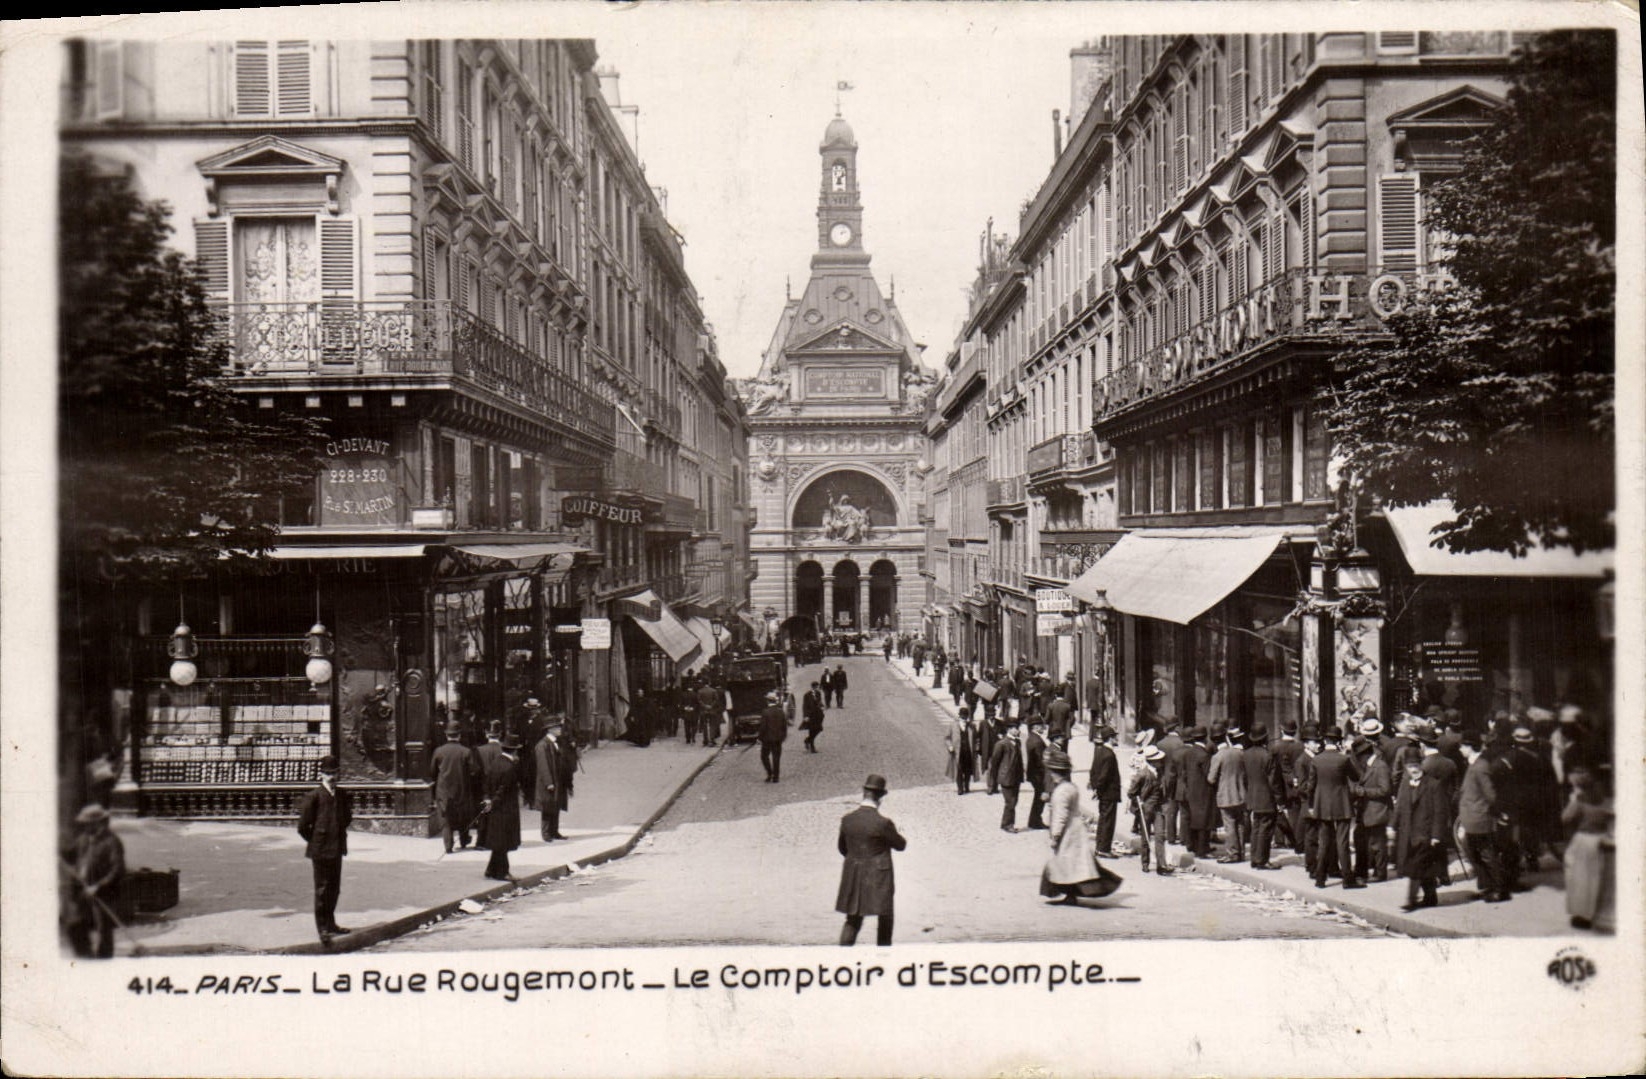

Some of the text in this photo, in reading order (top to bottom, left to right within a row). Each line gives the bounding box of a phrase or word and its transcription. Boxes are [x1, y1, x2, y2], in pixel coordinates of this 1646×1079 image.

[326, 438, 390, 456] CI-DEVANT
[330, 468, 387, 483] 228-230
[354, 494, 395, 514] MARTIN
[564, 499, 643, 524] COIFFEUR
